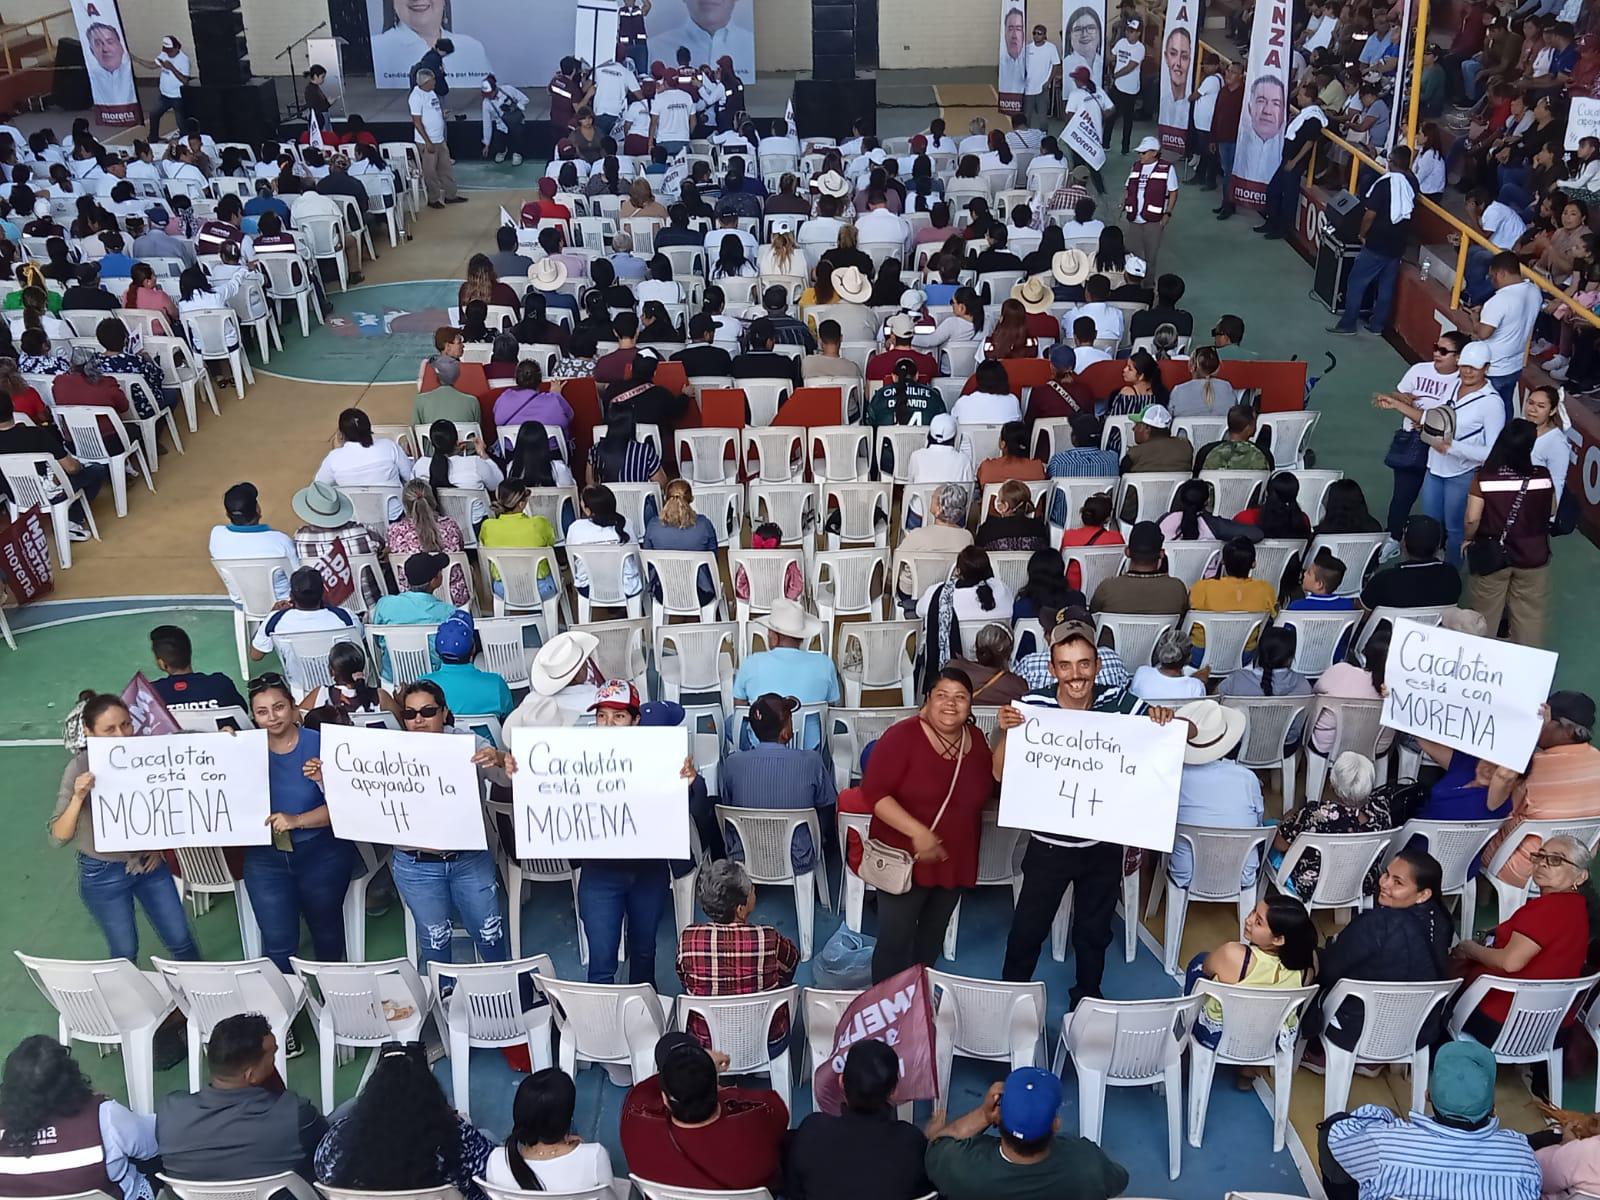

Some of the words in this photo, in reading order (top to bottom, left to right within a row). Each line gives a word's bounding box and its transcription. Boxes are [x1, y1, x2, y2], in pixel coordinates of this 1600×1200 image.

[1264, 0, 1288, 69] NZA
[101, 111, 135, 121] morena
[1070, 131, 1097, 158] morena
[1234, 186, 1267, 202] moren
[3, 543, 36, 597] morena
[22, 532, 49, 582] CASTRO
[1400, 630, 1503, 686] Cacalotán
[1405, 677, 1447, 693] está
[1461, 688, 1492, 704] con
[1024, 717, 1121, 753] Cacalotán
[1390, 687, 1496, 750] MORENA
[109, 745, 215, 769] Cacalotán
[335, 742, 431, 777] Cacalotán
[528, 741, 633, 777] Cacalotán
[1025, 750, 1104, 772] apoyando
[1120, 755, 1137, 775] la
[146, 767, 186, 784] está
[200, 771, 227, 781] con
[351, 776, 425, 798] apoyando
[438, 776, 457, 796] la
[538, 777, 581, 795] está
[596, 777, 626, 793] con
[98, 787, 233, 839] MORENA
[526, 801, 637, 845] MORENA
